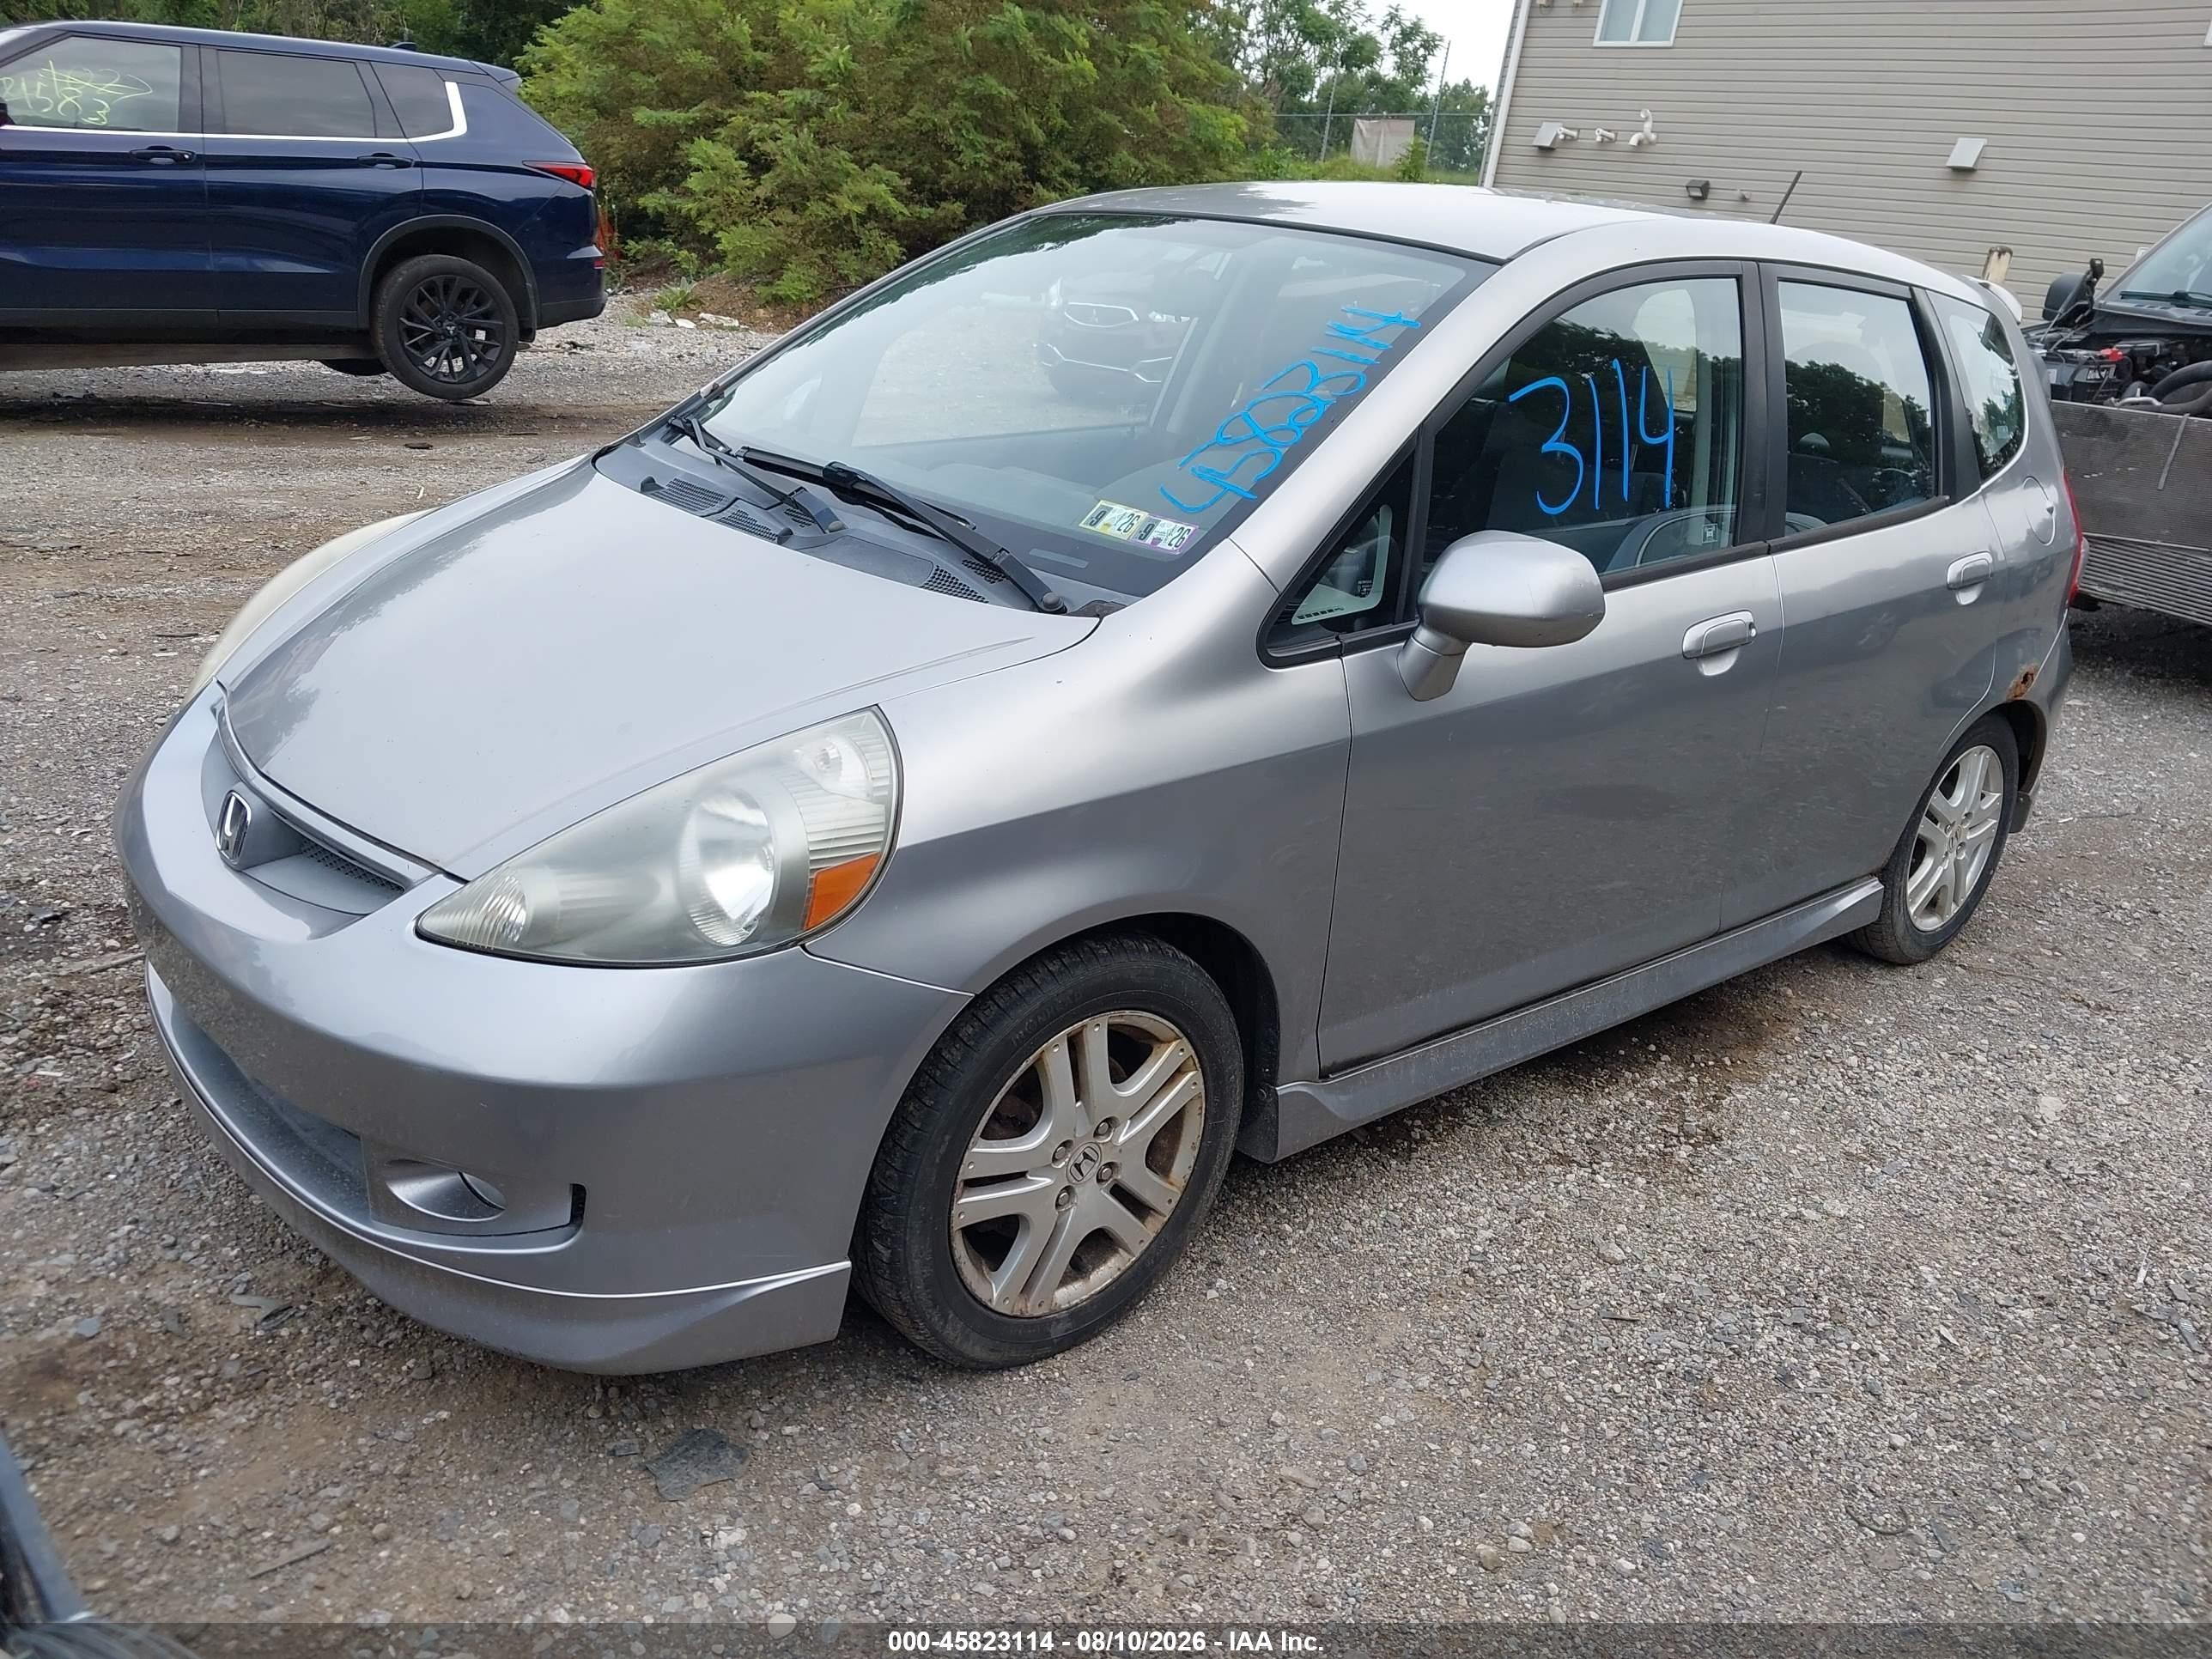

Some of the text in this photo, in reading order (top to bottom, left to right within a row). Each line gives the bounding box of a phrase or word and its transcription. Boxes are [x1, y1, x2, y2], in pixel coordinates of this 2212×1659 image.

[1509, 358, 1674, 515] 3114
[1116, 513, 1141, 533] 26
[1167, 526, 1191, 548] 26
